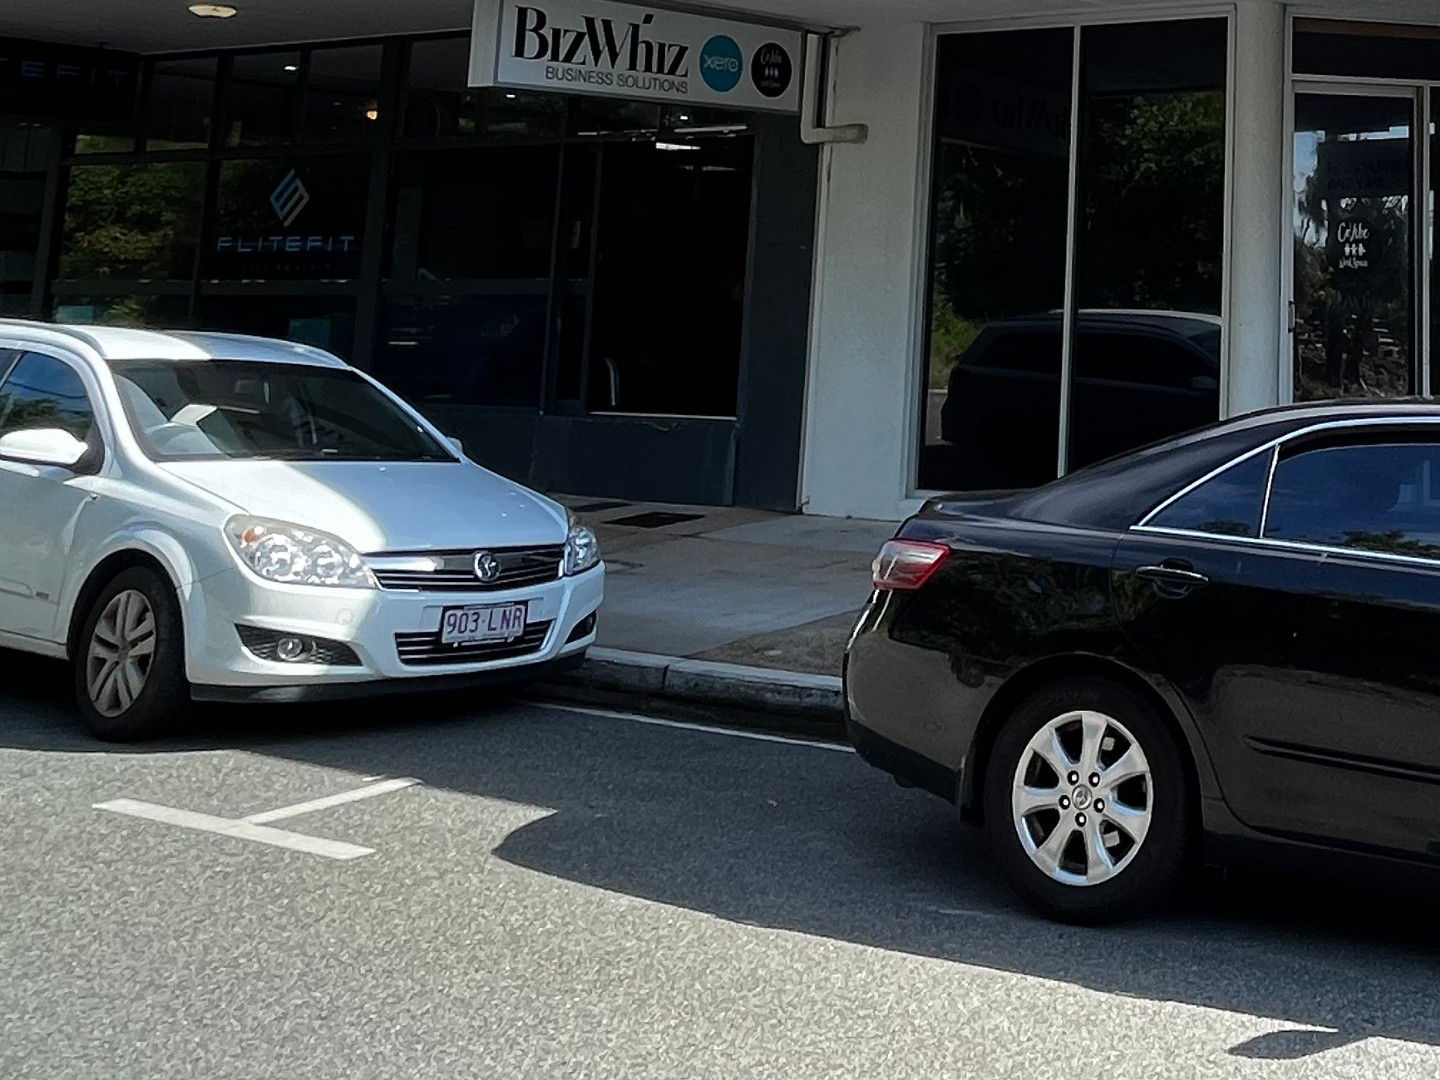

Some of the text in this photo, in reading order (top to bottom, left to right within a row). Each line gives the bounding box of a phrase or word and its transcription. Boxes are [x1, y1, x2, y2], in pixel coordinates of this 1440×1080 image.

[545, 65, 688, 95] BUSINESS SOLUTIONS
[447, 607, 522, 634] 903 LNR
